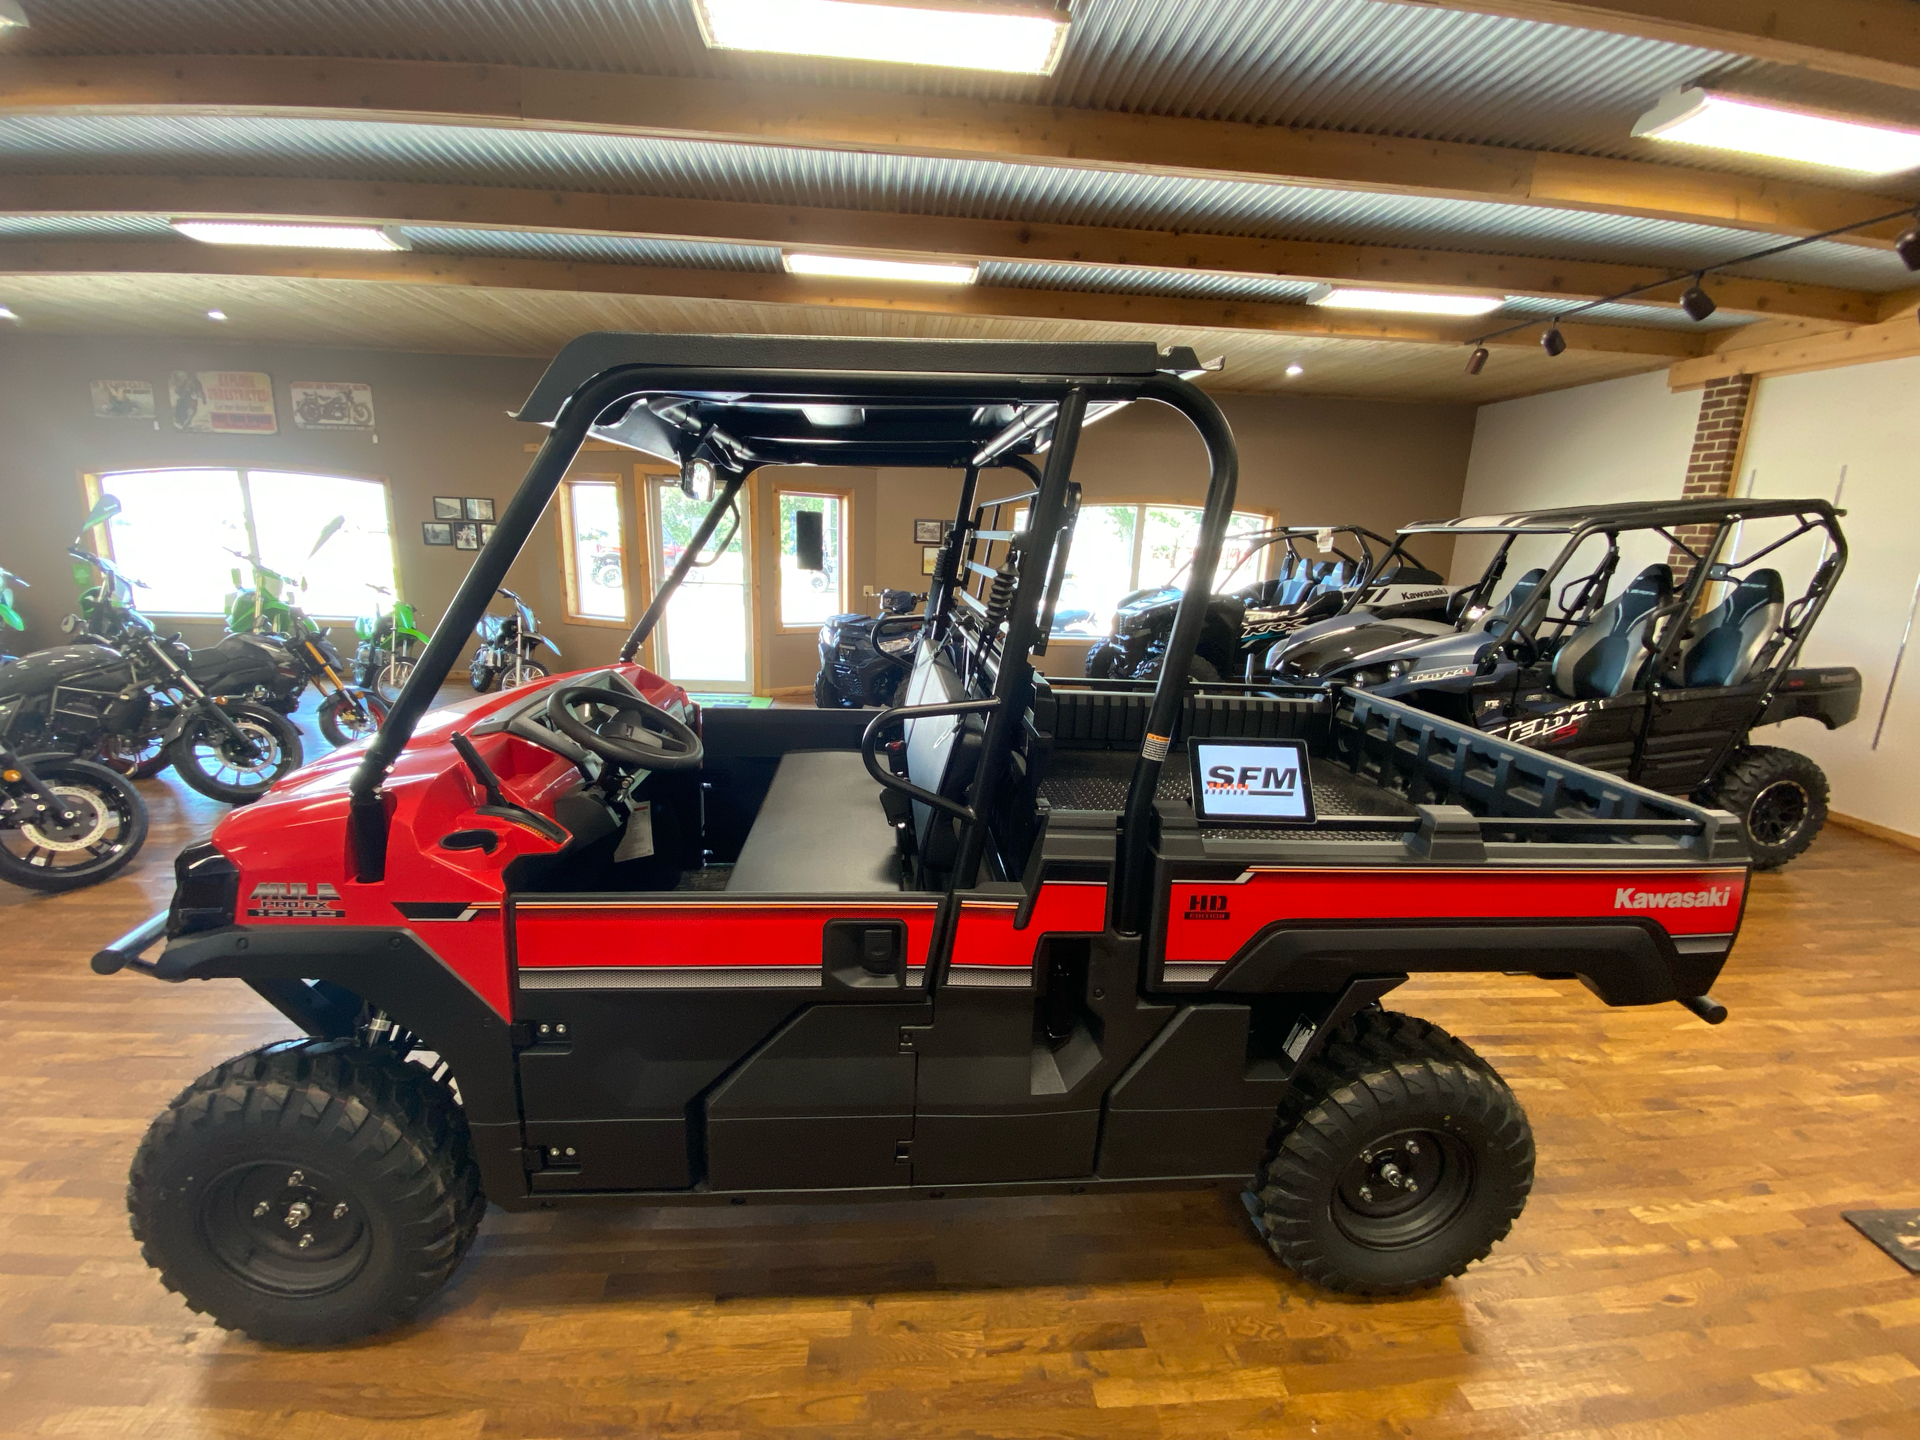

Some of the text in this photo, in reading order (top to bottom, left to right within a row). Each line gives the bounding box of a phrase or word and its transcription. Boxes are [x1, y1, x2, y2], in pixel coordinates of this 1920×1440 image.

[1401, 588, 1449, 600] Kawasaki
[1241, 617, 1309, 639] KRX
[1205, 765, 1297, 790] SFM
[250, 883, 342, 900] MULE
[1614, 887, 1731, 909] Kawasaki
[1189, 895, 1228, 911] HD
